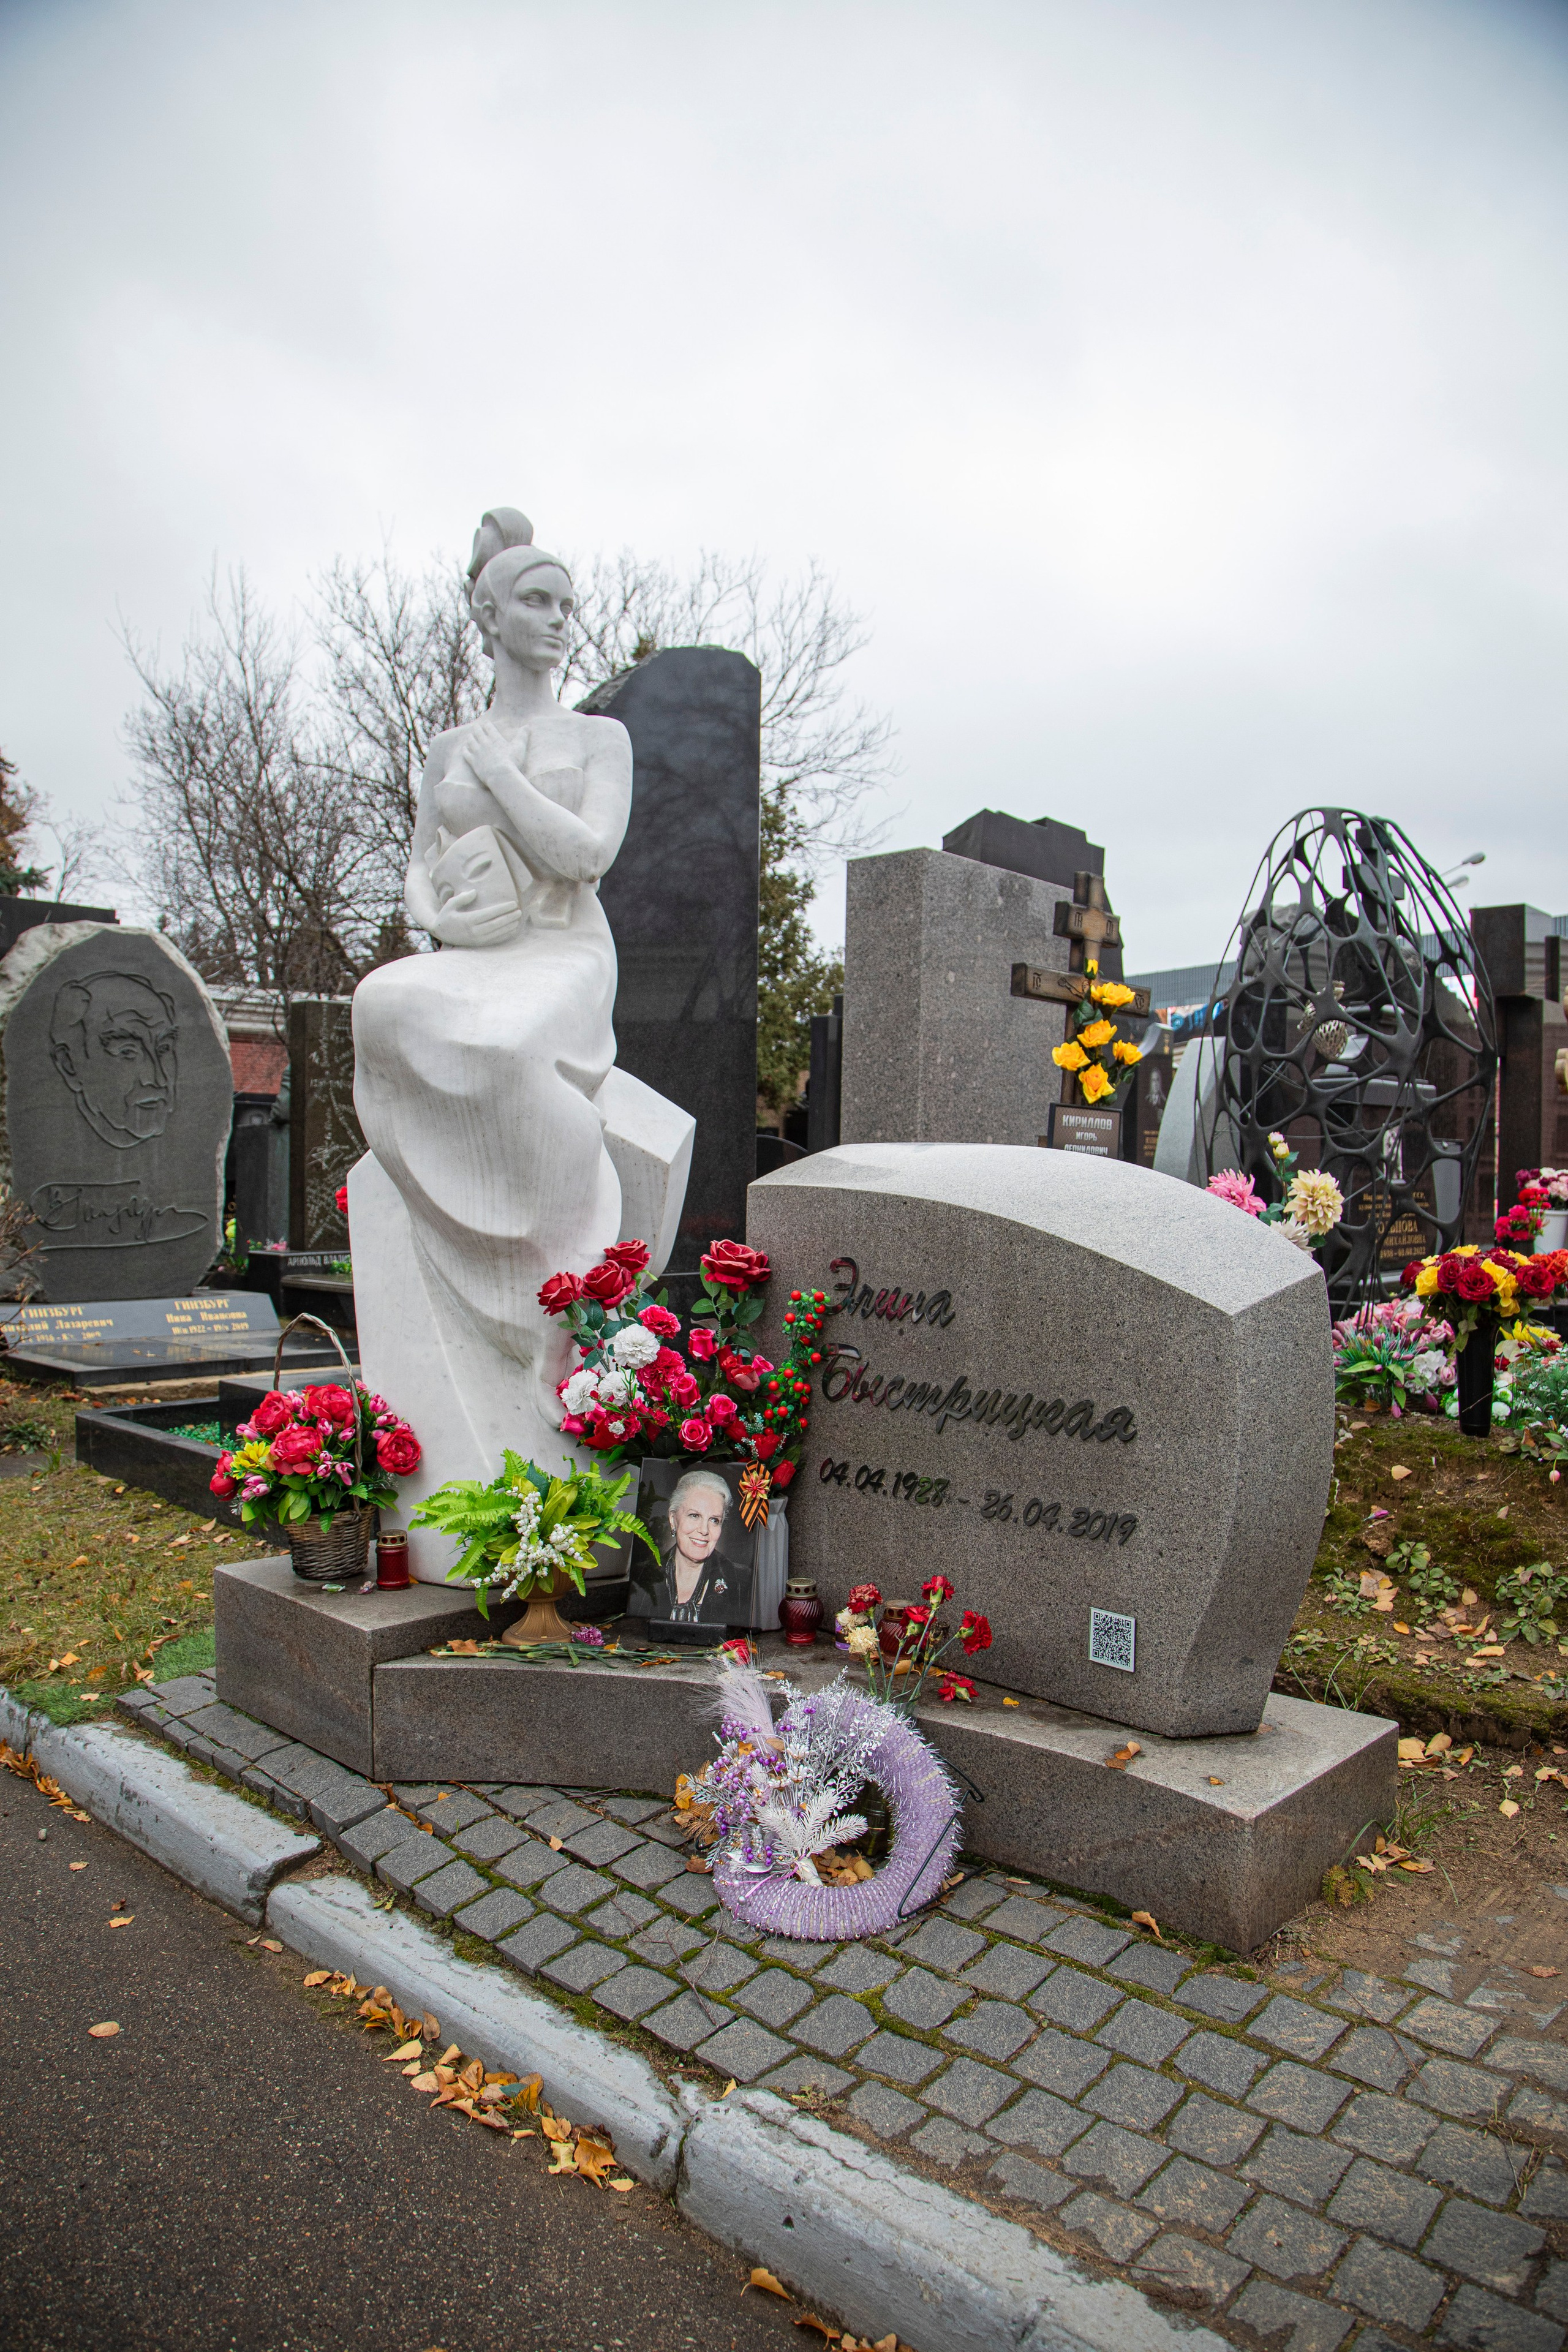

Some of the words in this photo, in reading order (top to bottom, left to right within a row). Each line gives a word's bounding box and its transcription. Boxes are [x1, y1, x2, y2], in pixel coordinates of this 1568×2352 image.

[1063, 1115, 1112, 1130] КИРИЛЛОВ
[1076, 1131, 1098, 1141] ИГОРЬ
[824, 1257, 955, 1327] Элина
[174, 1298, 230, 1311] ГИНЗБУРГ
[21, 1306, 85, 1318] ГИНЗБУРГ
[165, 1313, 192, 1324] Нина
[200, 1311, 247, 1321] Ивановна
[55, 1319, 114, 1330] Лазаревич
[821, 1343, 1137, 1441] Быстрицкая
[820, 1457, 950, 1507] 04.04.1928
[981, 1489, 1137, 1546] 26.04.2019
